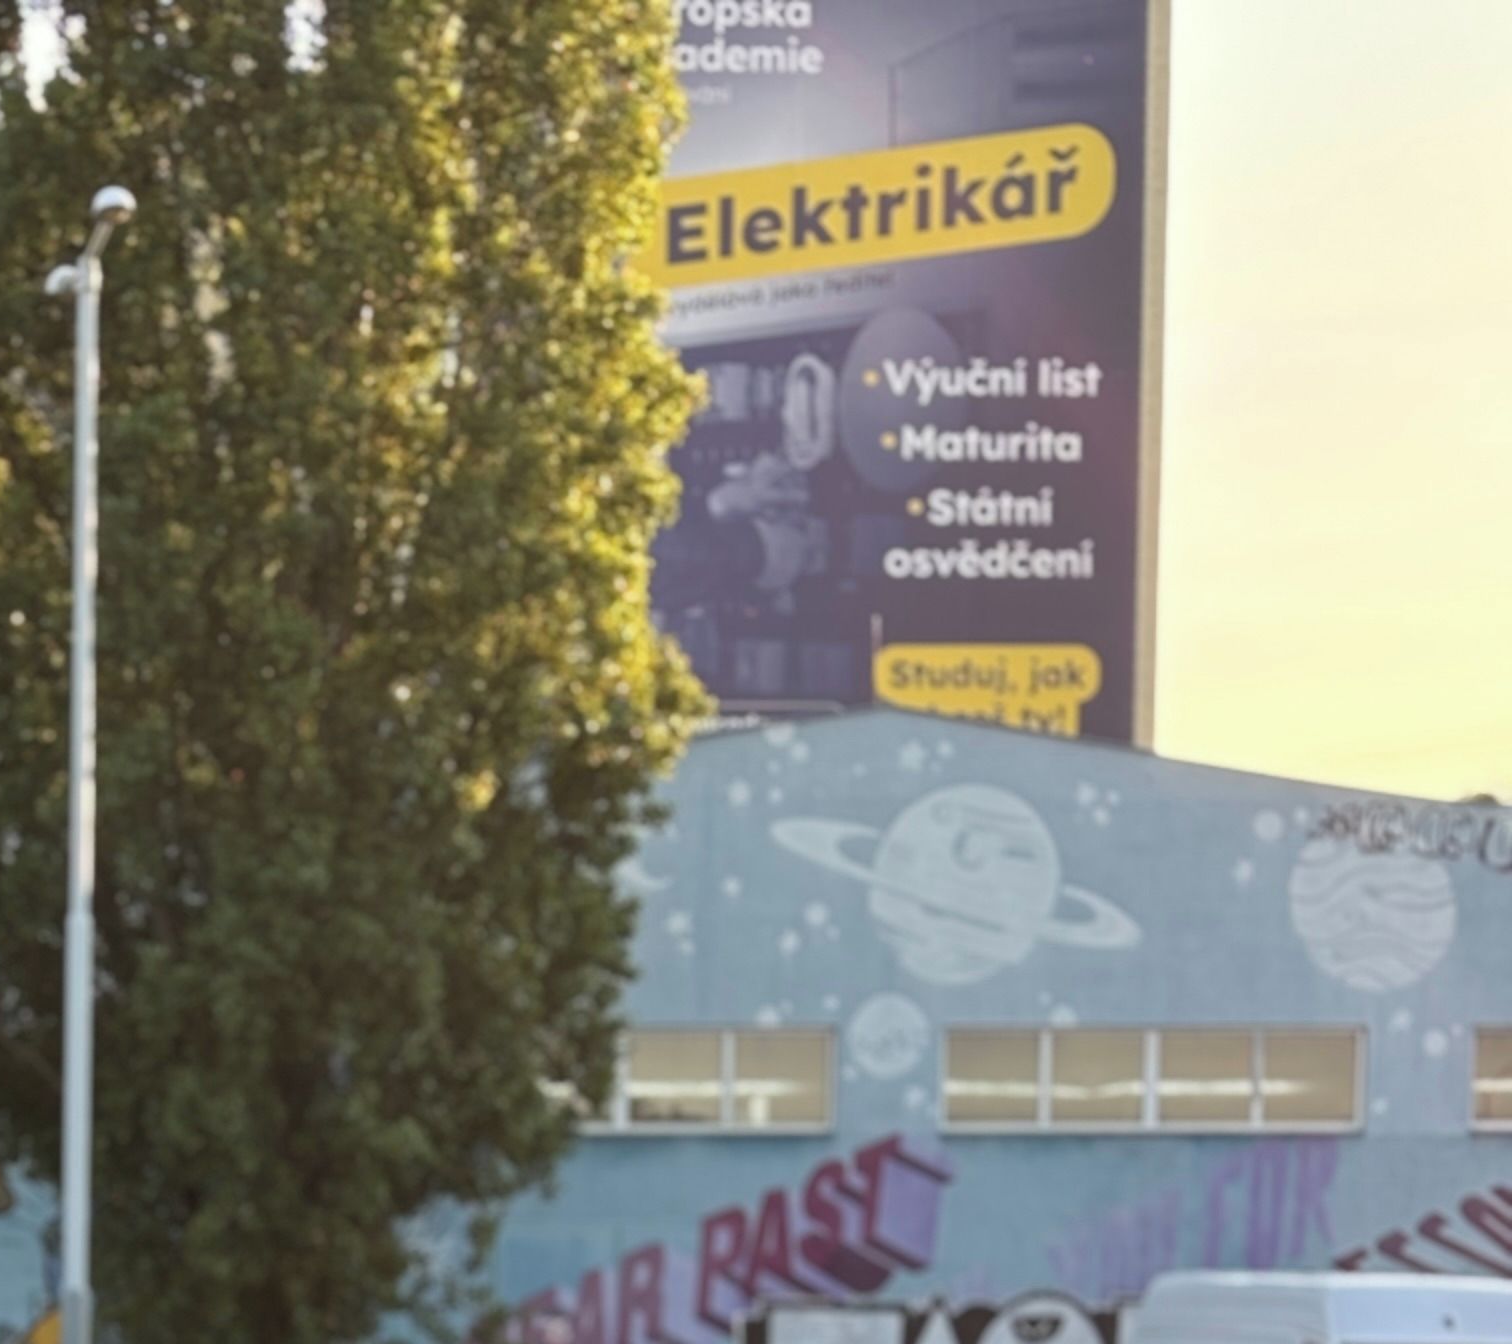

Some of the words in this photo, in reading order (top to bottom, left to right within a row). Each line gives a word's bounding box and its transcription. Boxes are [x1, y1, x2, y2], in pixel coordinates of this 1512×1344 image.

[672, 35, 825, 74] ademie
[665, 145, 1080, 265] Elektrikář
[883, 356, 1028, 406] Výuční
[1037, 356, 1103, 398] list
[900, 420, 1083, 462] Maturita
[926, 484, 1055, 527] Státní
[883, 538, 1095, 579] osvědčení
[1029, 656, 1087, 695] jak
